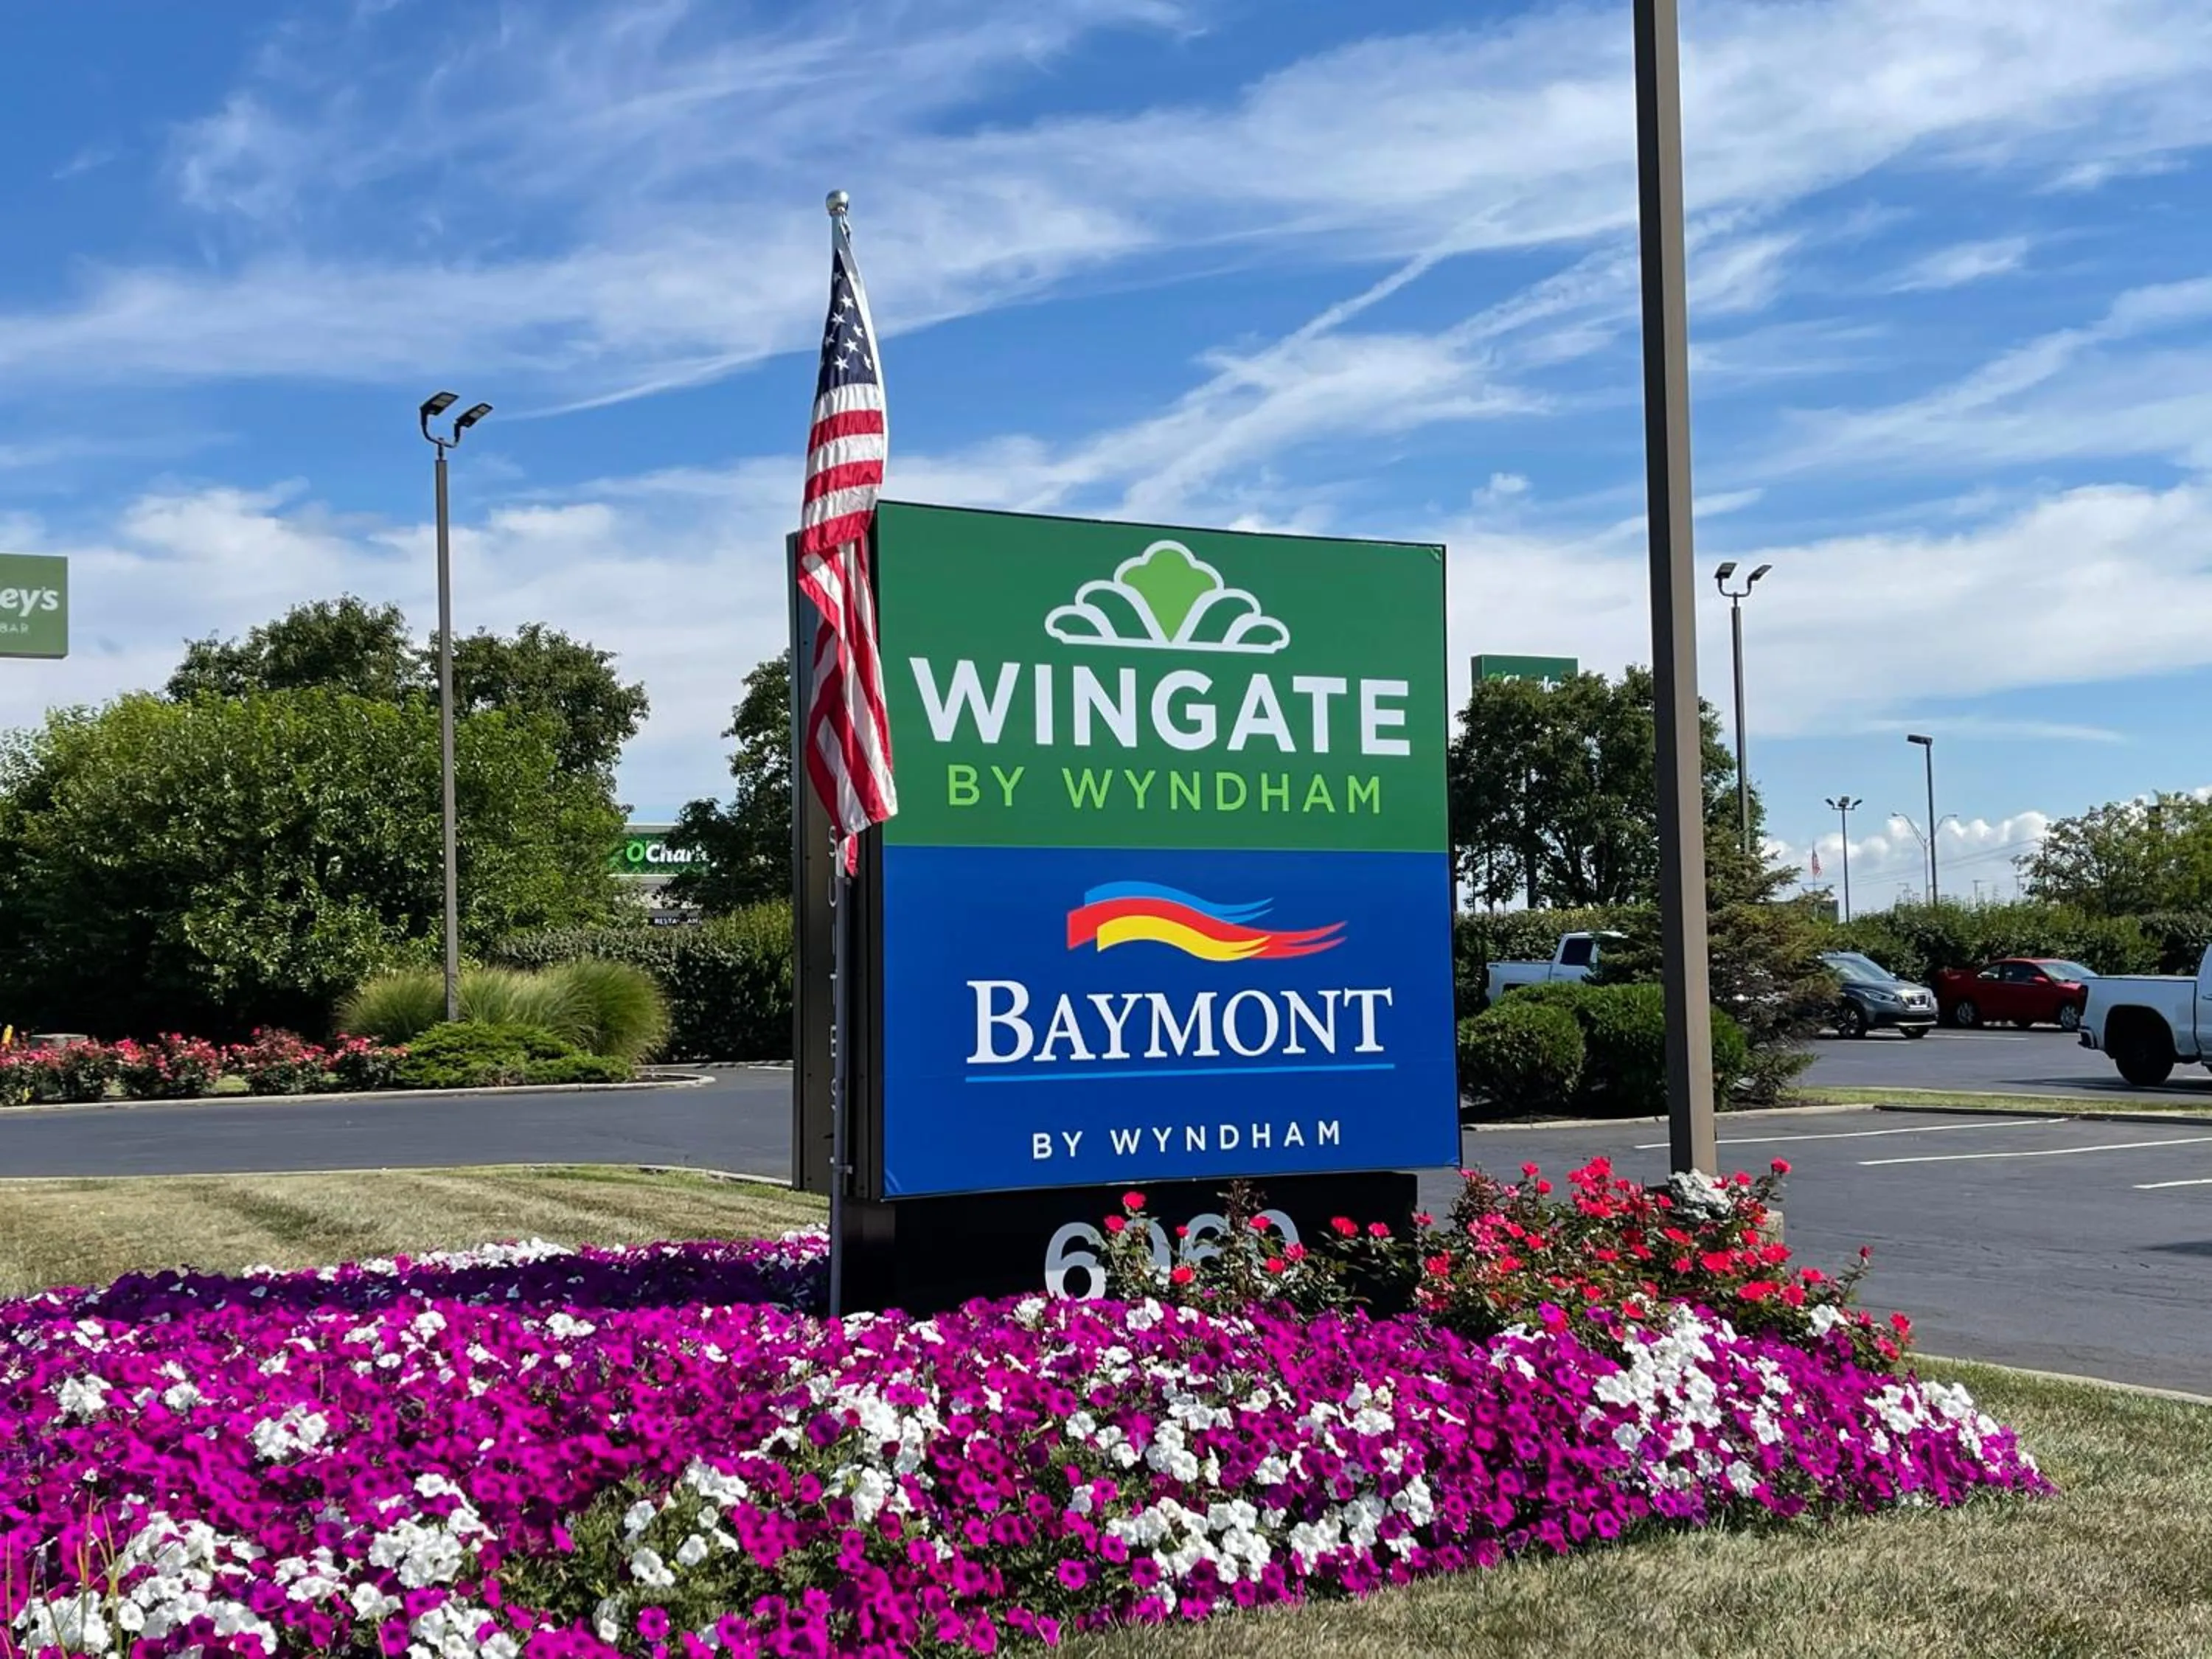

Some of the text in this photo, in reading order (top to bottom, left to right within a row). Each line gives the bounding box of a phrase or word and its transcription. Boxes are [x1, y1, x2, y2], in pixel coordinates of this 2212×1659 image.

[908, 657, 1411, 756] WINGATE
[947, 764, 1381, 814] BY WYNDHAM
[1033, 1120, 1341, 1159] BY WYNDHAM
